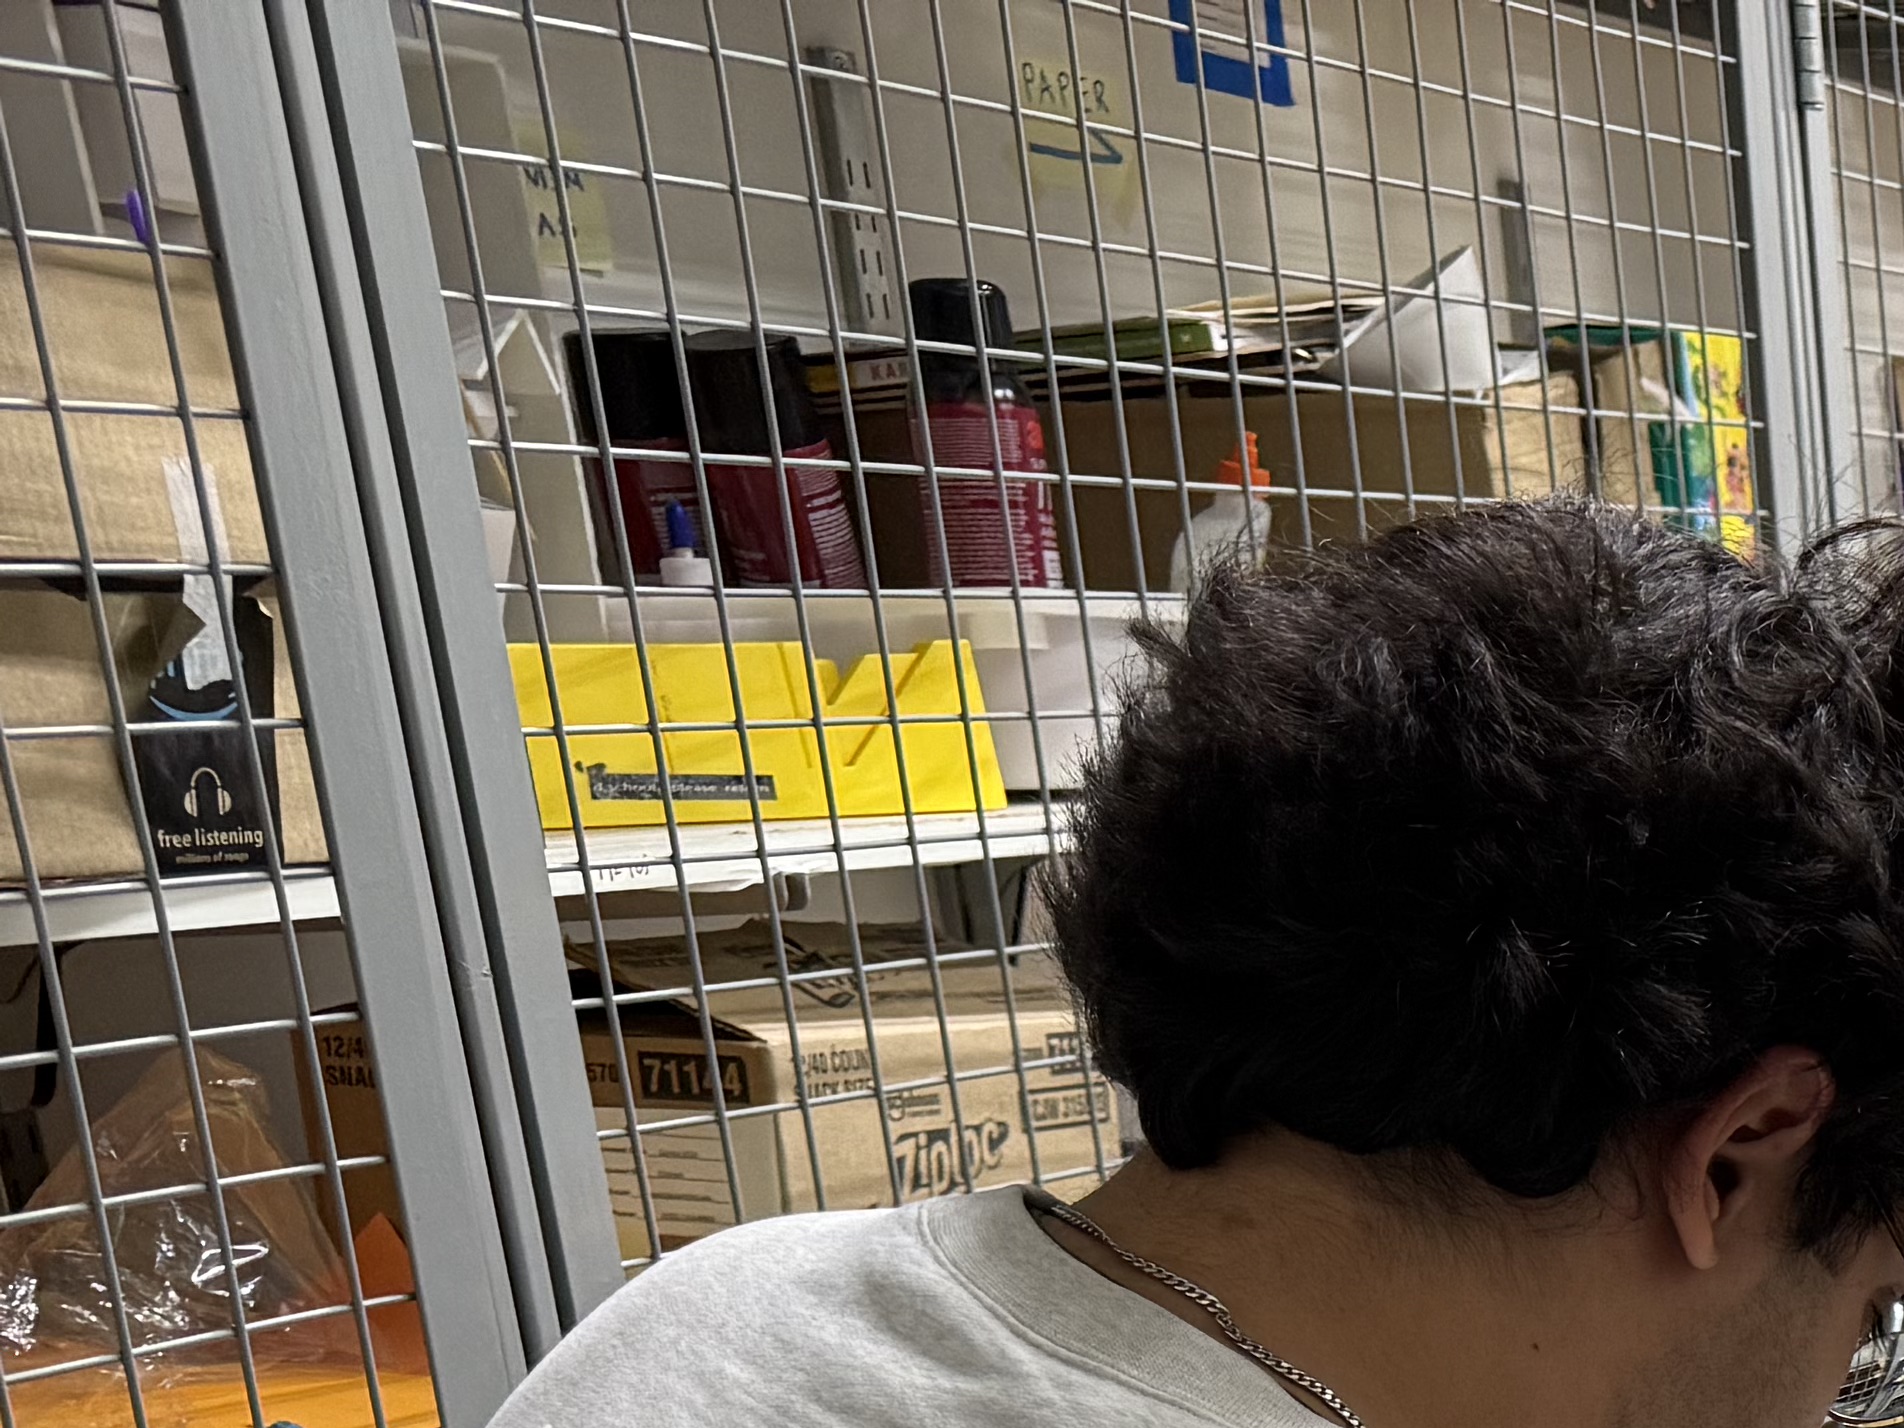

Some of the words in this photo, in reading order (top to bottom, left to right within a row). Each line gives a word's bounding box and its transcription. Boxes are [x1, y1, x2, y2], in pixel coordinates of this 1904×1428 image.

[1021, 62, 1110, 114] PAPER
[157, 829, 192, 848] free
[195, 827, 264, 849] listening
[642, 1058, 743, 1097] 71144
[830, 1048, 872, 1074] COUN
[896, 1119, 1008, 1197] Ziploc
